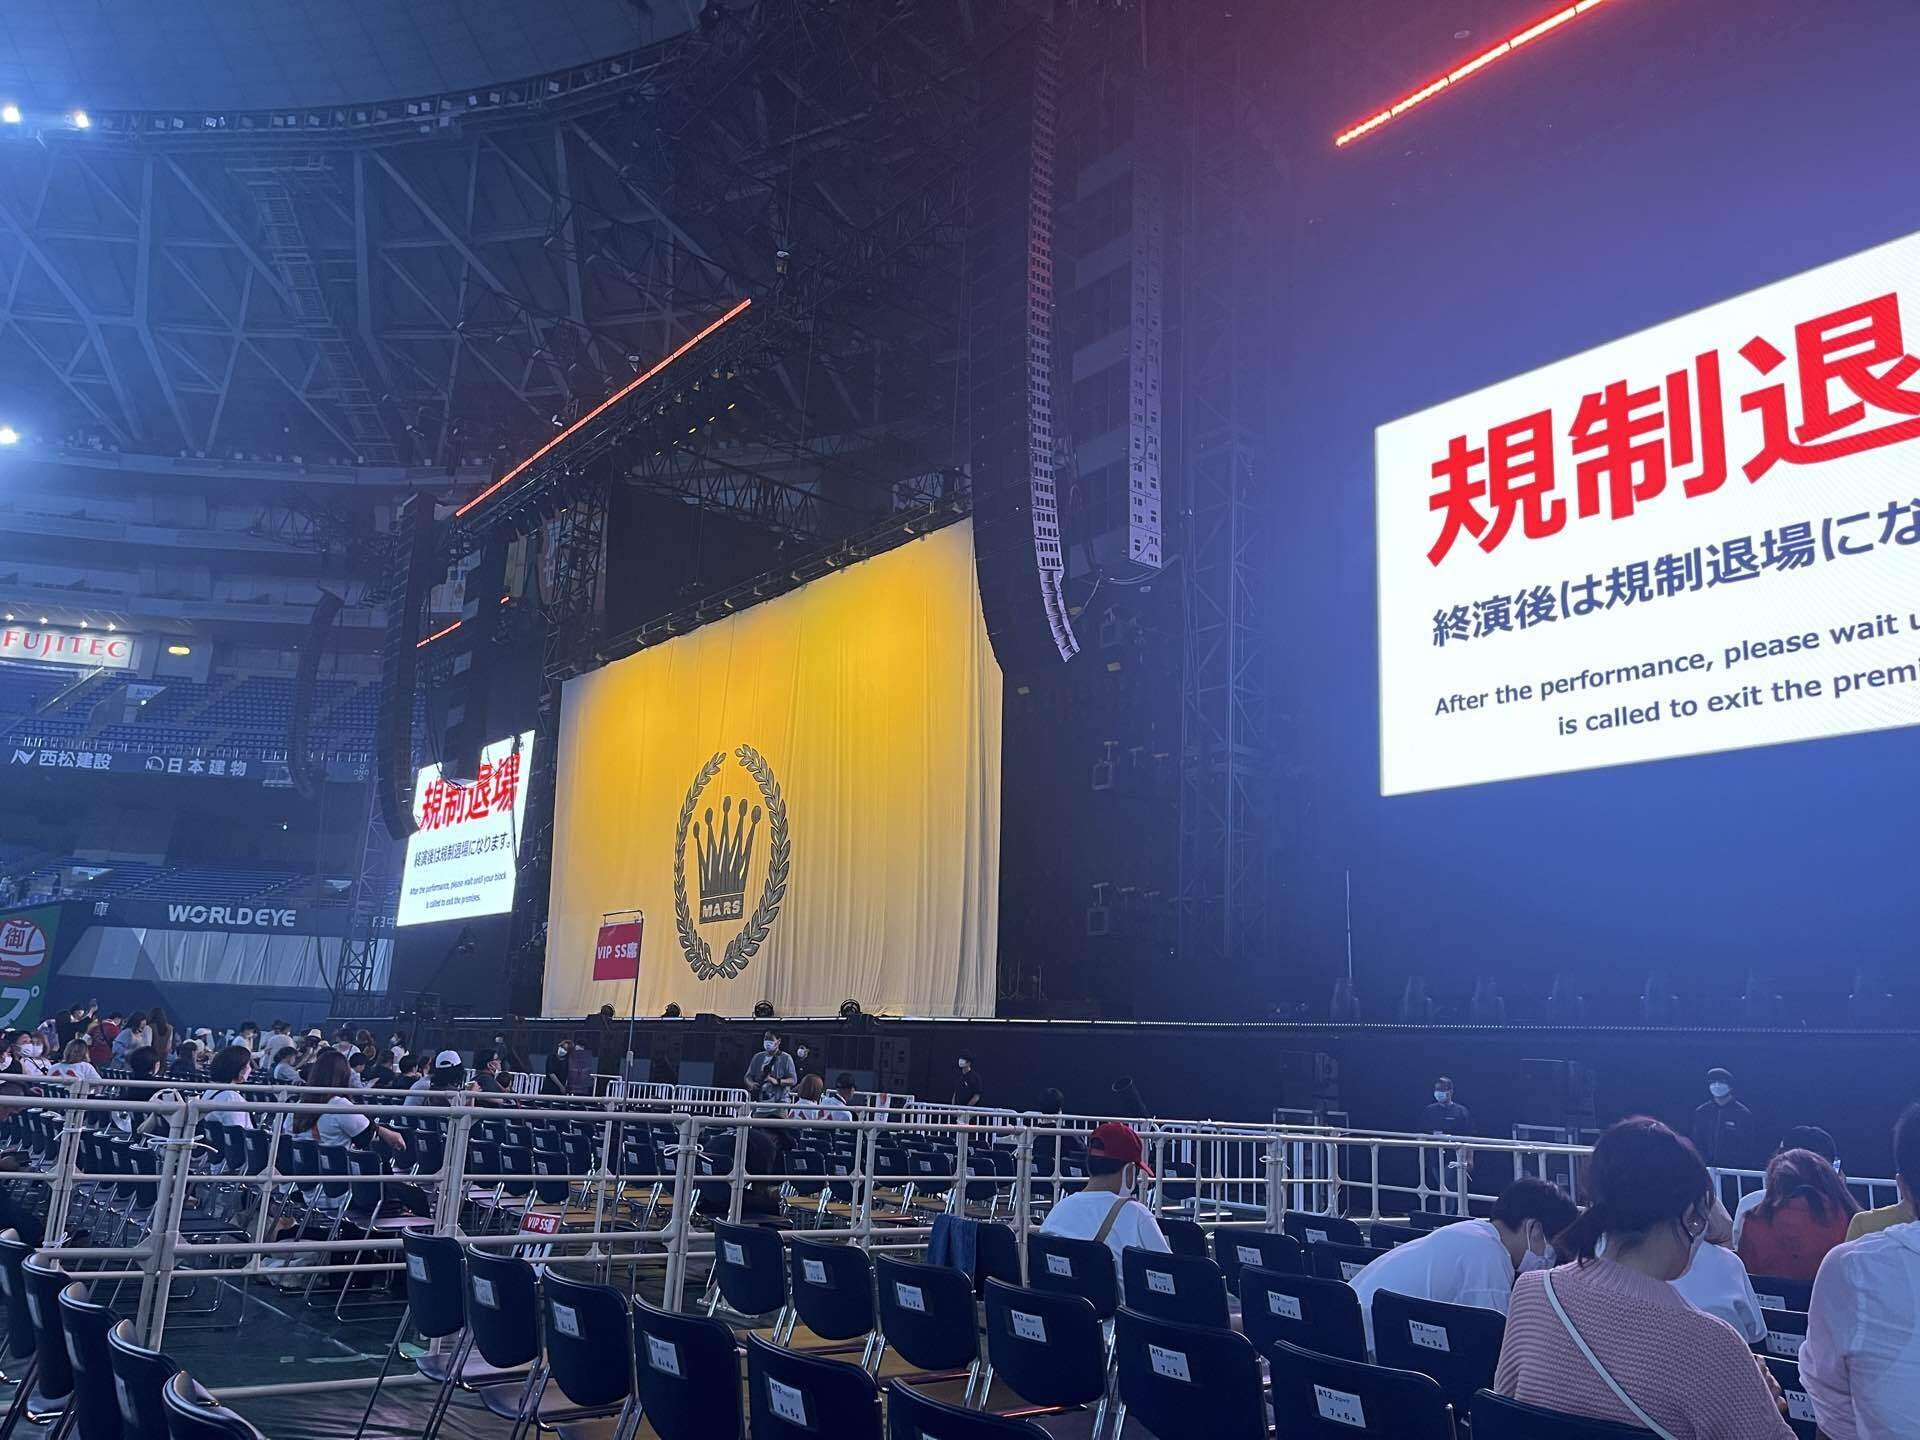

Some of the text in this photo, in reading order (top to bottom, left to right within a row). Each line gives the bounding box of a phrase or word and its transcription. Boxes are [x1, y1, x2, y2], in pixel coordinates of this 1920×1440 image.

[3, 630, 127, 658] FUJITEC
[1435, 692, 1489, 716] After
[1496, 685, 1533, 705] the
[1541, 653, 1714, 702] performance,
[1724, 632, 1820, 670] please
[1830, 613, 1900, 645] wait
[1558, 716, 1578, 736] is
[1585, 701, 1661, 731] called
[1669, 697, 1698, 718] to
[1707, 685, 1763, 712] exit
[1770, 679, 1822, 703] the
[39, 749, 112, 770] 西松建設
[167, 758, 247, 777] 日本建物
[419, 752, 520, 832] 規制退場
[702, 900, 741, 918] MARS
[5, 927, 26, 949] 御
[597, 945, 612, 959] VIP
[527, 1216, 540, 1230] VIP
